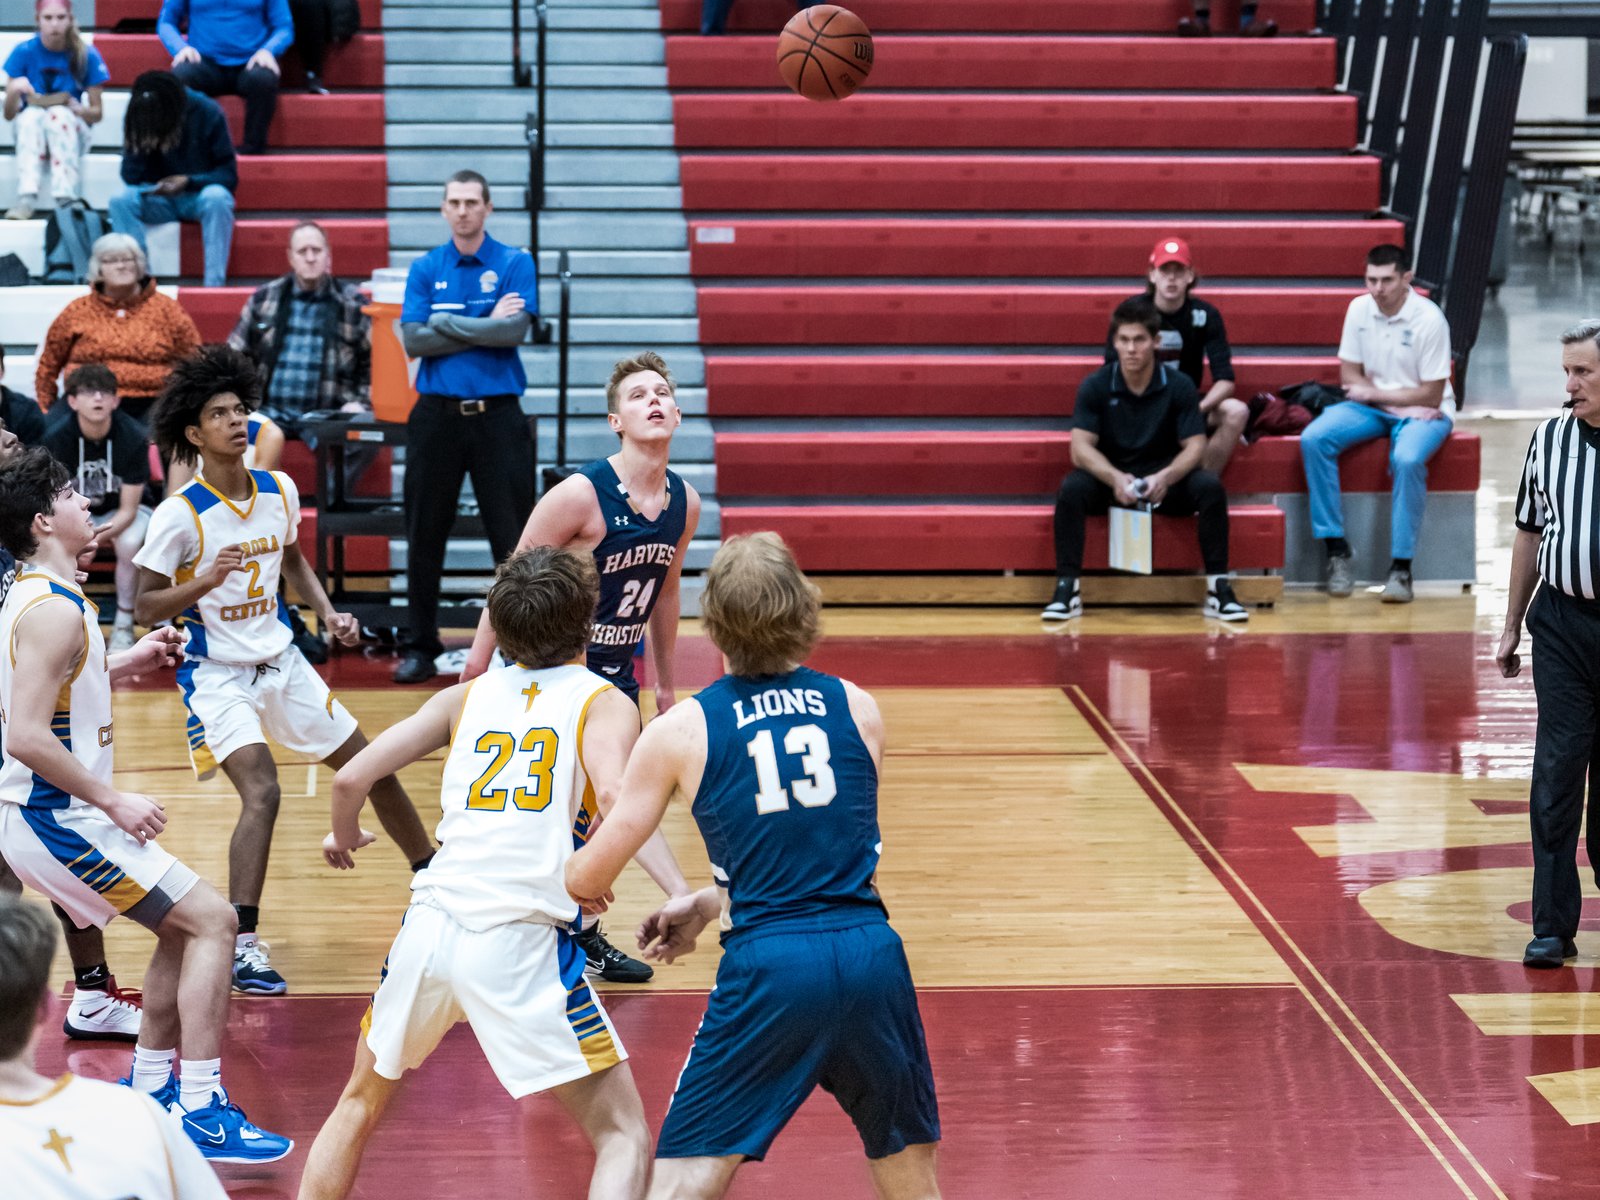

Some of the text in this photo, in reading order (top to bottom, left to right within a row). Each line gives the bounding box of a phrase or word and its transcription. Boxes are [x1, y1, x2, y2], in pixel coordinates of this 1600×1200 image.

[244, 560, 264, 599] 2
[615, 578, 656, 618] 24
[732, 688, 827, 730] LIONS
[464, 726, 560, 813] 23
[746, 723, 838, 816] 13
